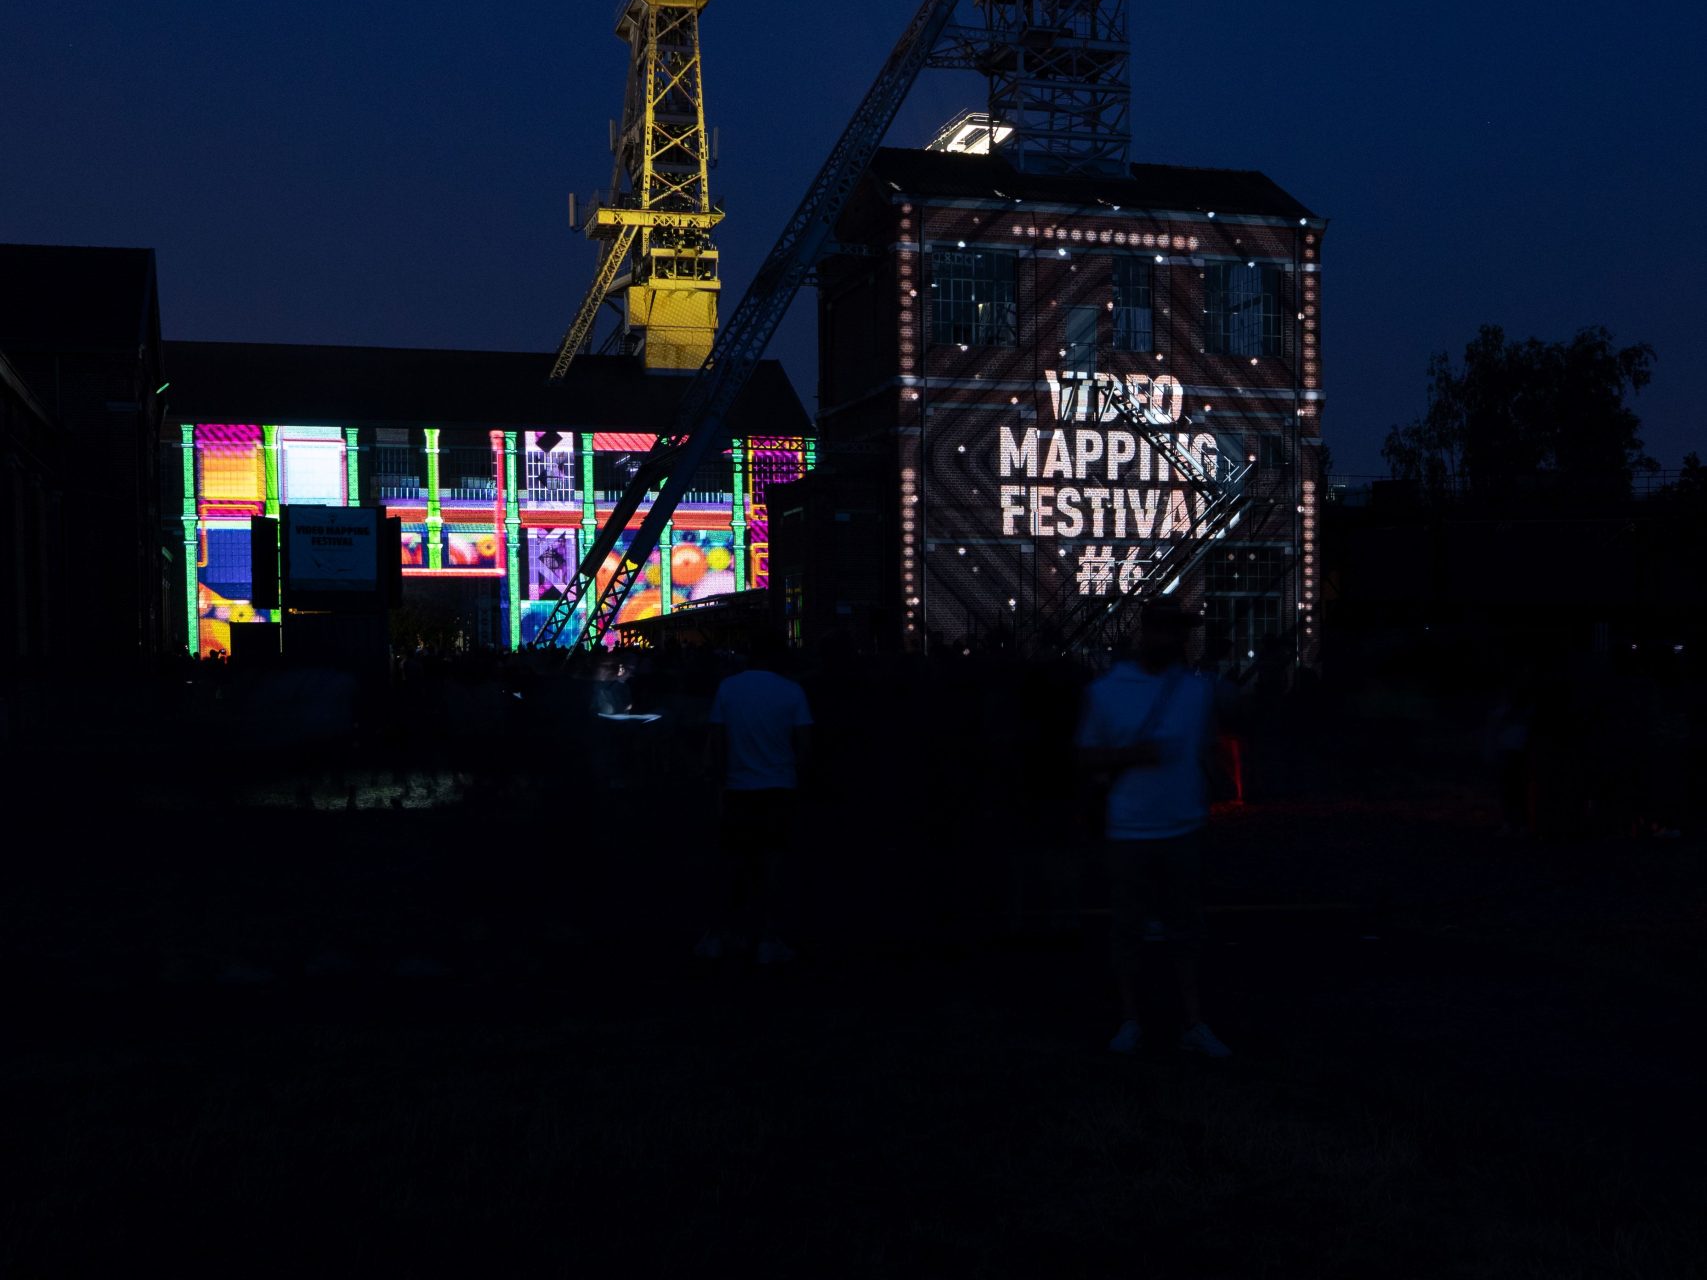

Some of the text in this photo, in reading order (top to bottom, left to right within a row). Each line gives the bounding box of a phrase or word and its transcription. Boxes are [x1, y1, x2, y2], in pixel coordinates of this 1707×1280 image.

[1000, 426, 1218, 482] MAPPING
[295, 526, 370, 536] VIDEO MAPPING
[311, 537, 353, 546] FESTIVAL
[1076, 545, 1144, 595] #6
